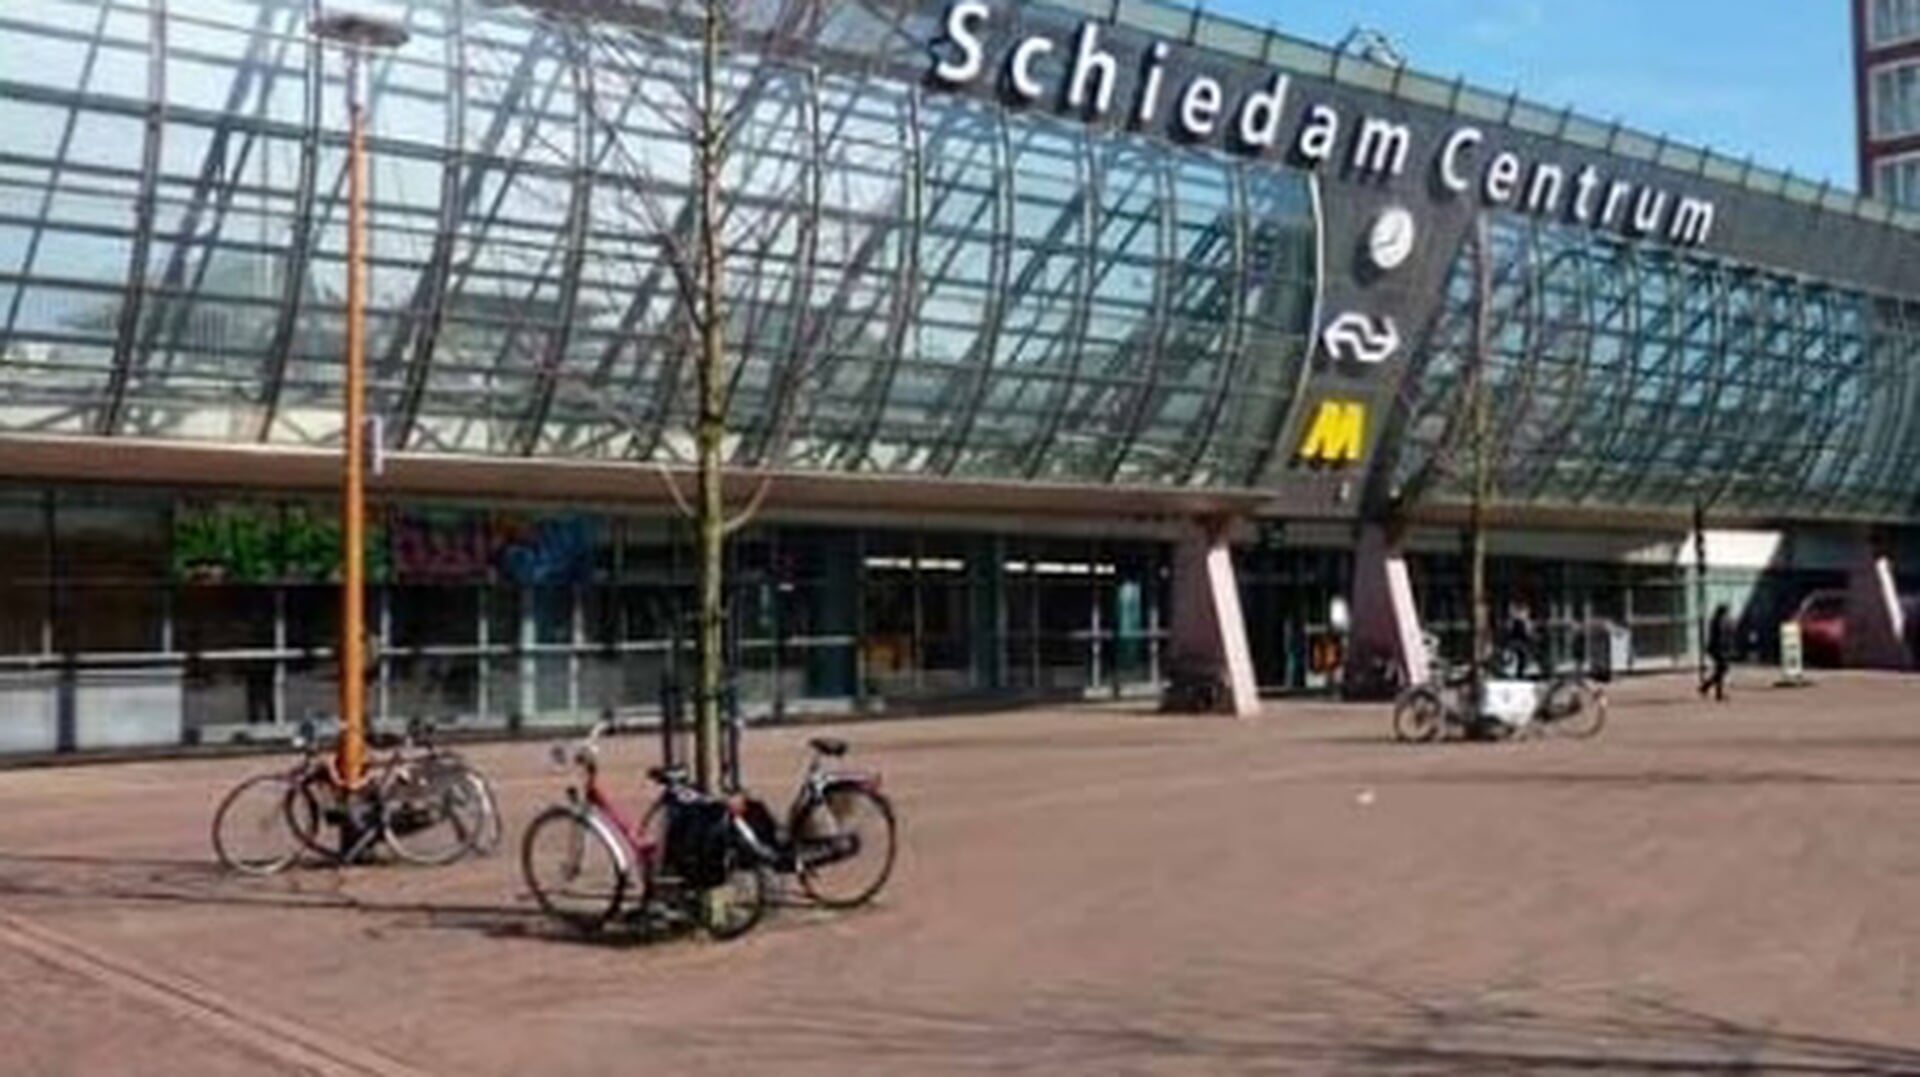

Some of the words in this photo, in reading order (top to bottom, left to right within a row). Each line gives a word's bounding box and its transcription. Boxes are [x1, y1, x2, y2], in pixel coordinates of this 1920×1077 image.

[936, 0, 1411, 174] Schiedam
[1441, 127, 1714, 242] Centrum
[1301, 401, 1366, 459] M
